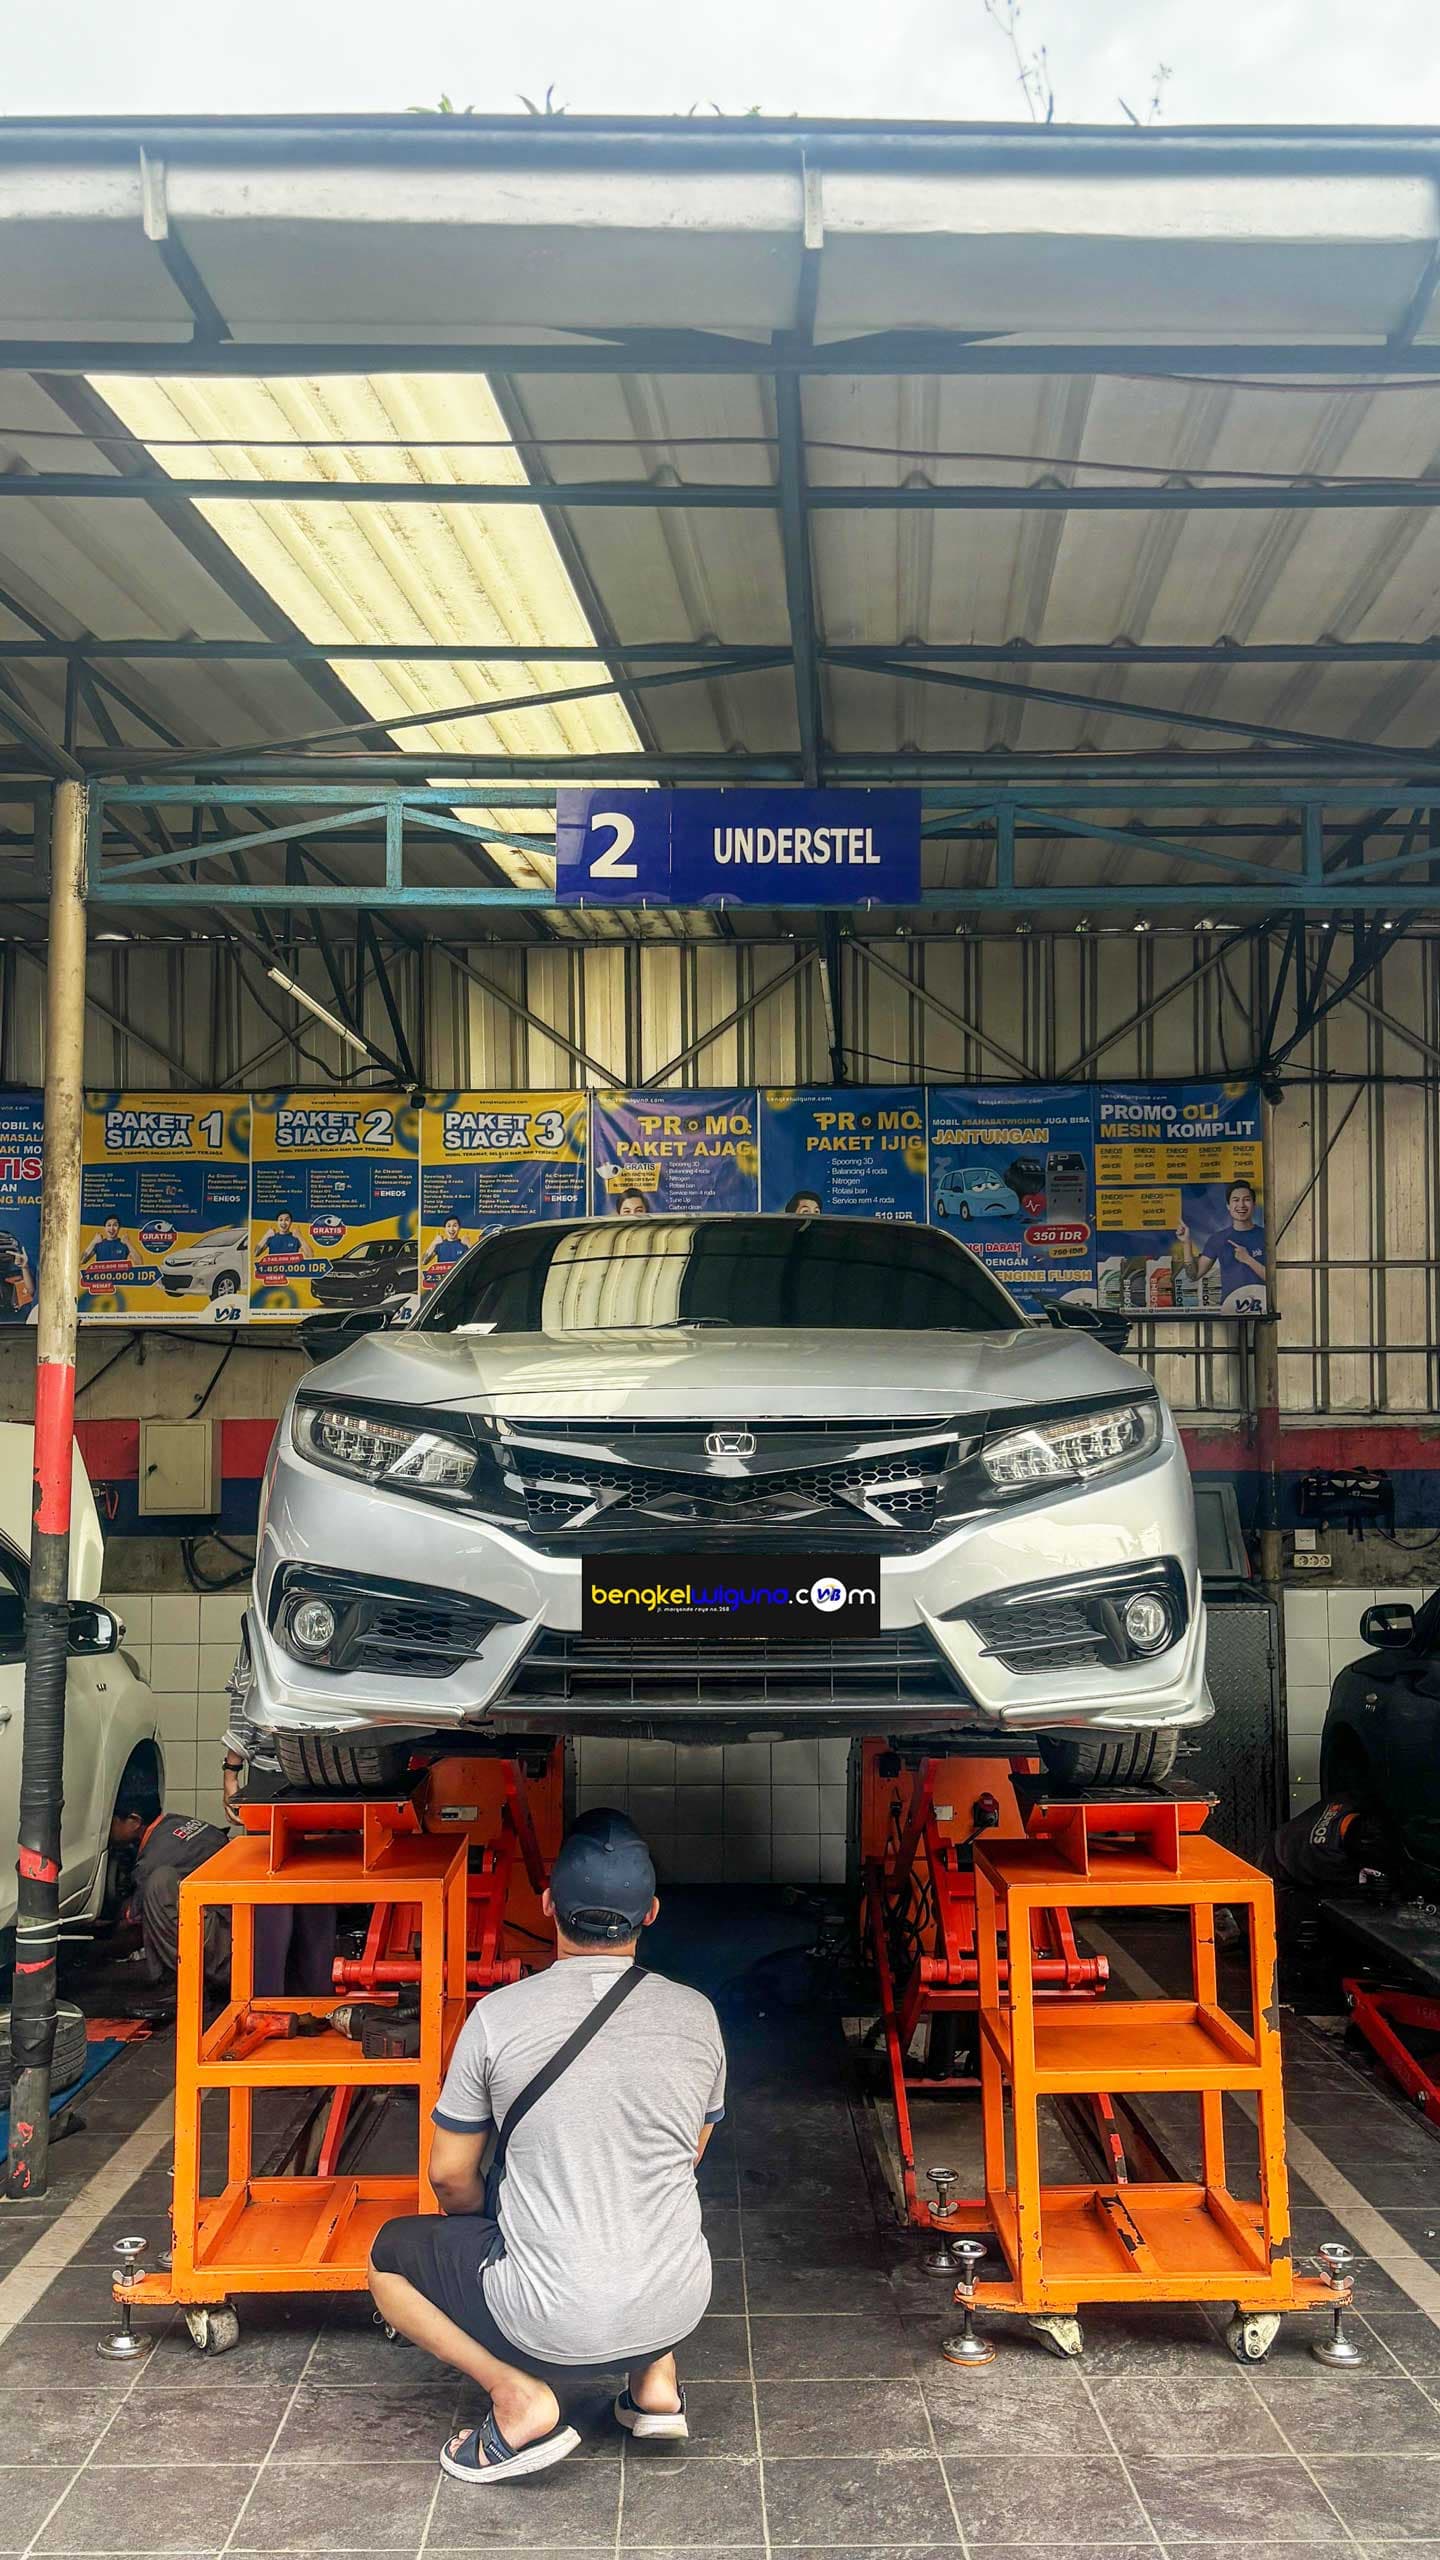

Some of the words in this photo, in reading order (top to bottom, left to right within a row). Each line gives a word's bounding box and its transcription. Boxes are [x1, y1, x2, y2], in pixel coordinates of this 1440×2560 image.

[589, 812, 638, 879] 2
[714, 827, 881, 864] UNDERSTEL
[279, 1111, 360, 1127] PAKET
[1100, 1104, 1177, 1121] PROMO
[1182, 1103, 1220, 1120] OLI
[0, 1121, 30, 1130] OBIL
[107, 1112, 193, 1129] PAKET
[363, 1110, 393, 1145] 2
[446, 1113, 530, 1129] PAKET
[1043, 1117, 1068, 1125] JUGA
[1070, 1116, 1090, 1124] BISA
[200, 1111, 222, 1147] 1
[276, 1128, 359, 1146] SIAGA
[535, 1111, 565, 1148] 3
[932, 1128, 1049, 1145] JANTUNGAN
[1100, 1123, 1161, 1138] MESIN
[1166, 1120, 1255, 1138] KOMPLIT
[106, 1129, 192, 1148] SIAGA
[444, 1130, 529, 1149] SIAGA
[806, 1135, 875, 1151] PAKET
[881, 1135, 923, 1151] IJIG
[616, 1141, 688, 1157] PAKET
[832, 1158, 862, 1166] Spooring
[863, 1157, 874, 1165] 3D
[832, 1167, 865, 1176] Balancing
[872, 1167, 888, 1175] roda
[832, 1177, 860, 1186] Nitrogen
[854, 1187, 868, 1195] ban
[895, 1211, 913, 1220] IDR
[1033, 1231, 1057, 1241] 350
[1060, 1231, 1082, 1240] IDR
[308, 1263, 327, 1273] IDR
[986, 1258, 1029, 1266] DENGAN
[138, 1270, 156, 1280] IDR
[996, 1270, 1046, 1281] ENGINE
[1048, 1270, 1092, 1281] FLUSH
